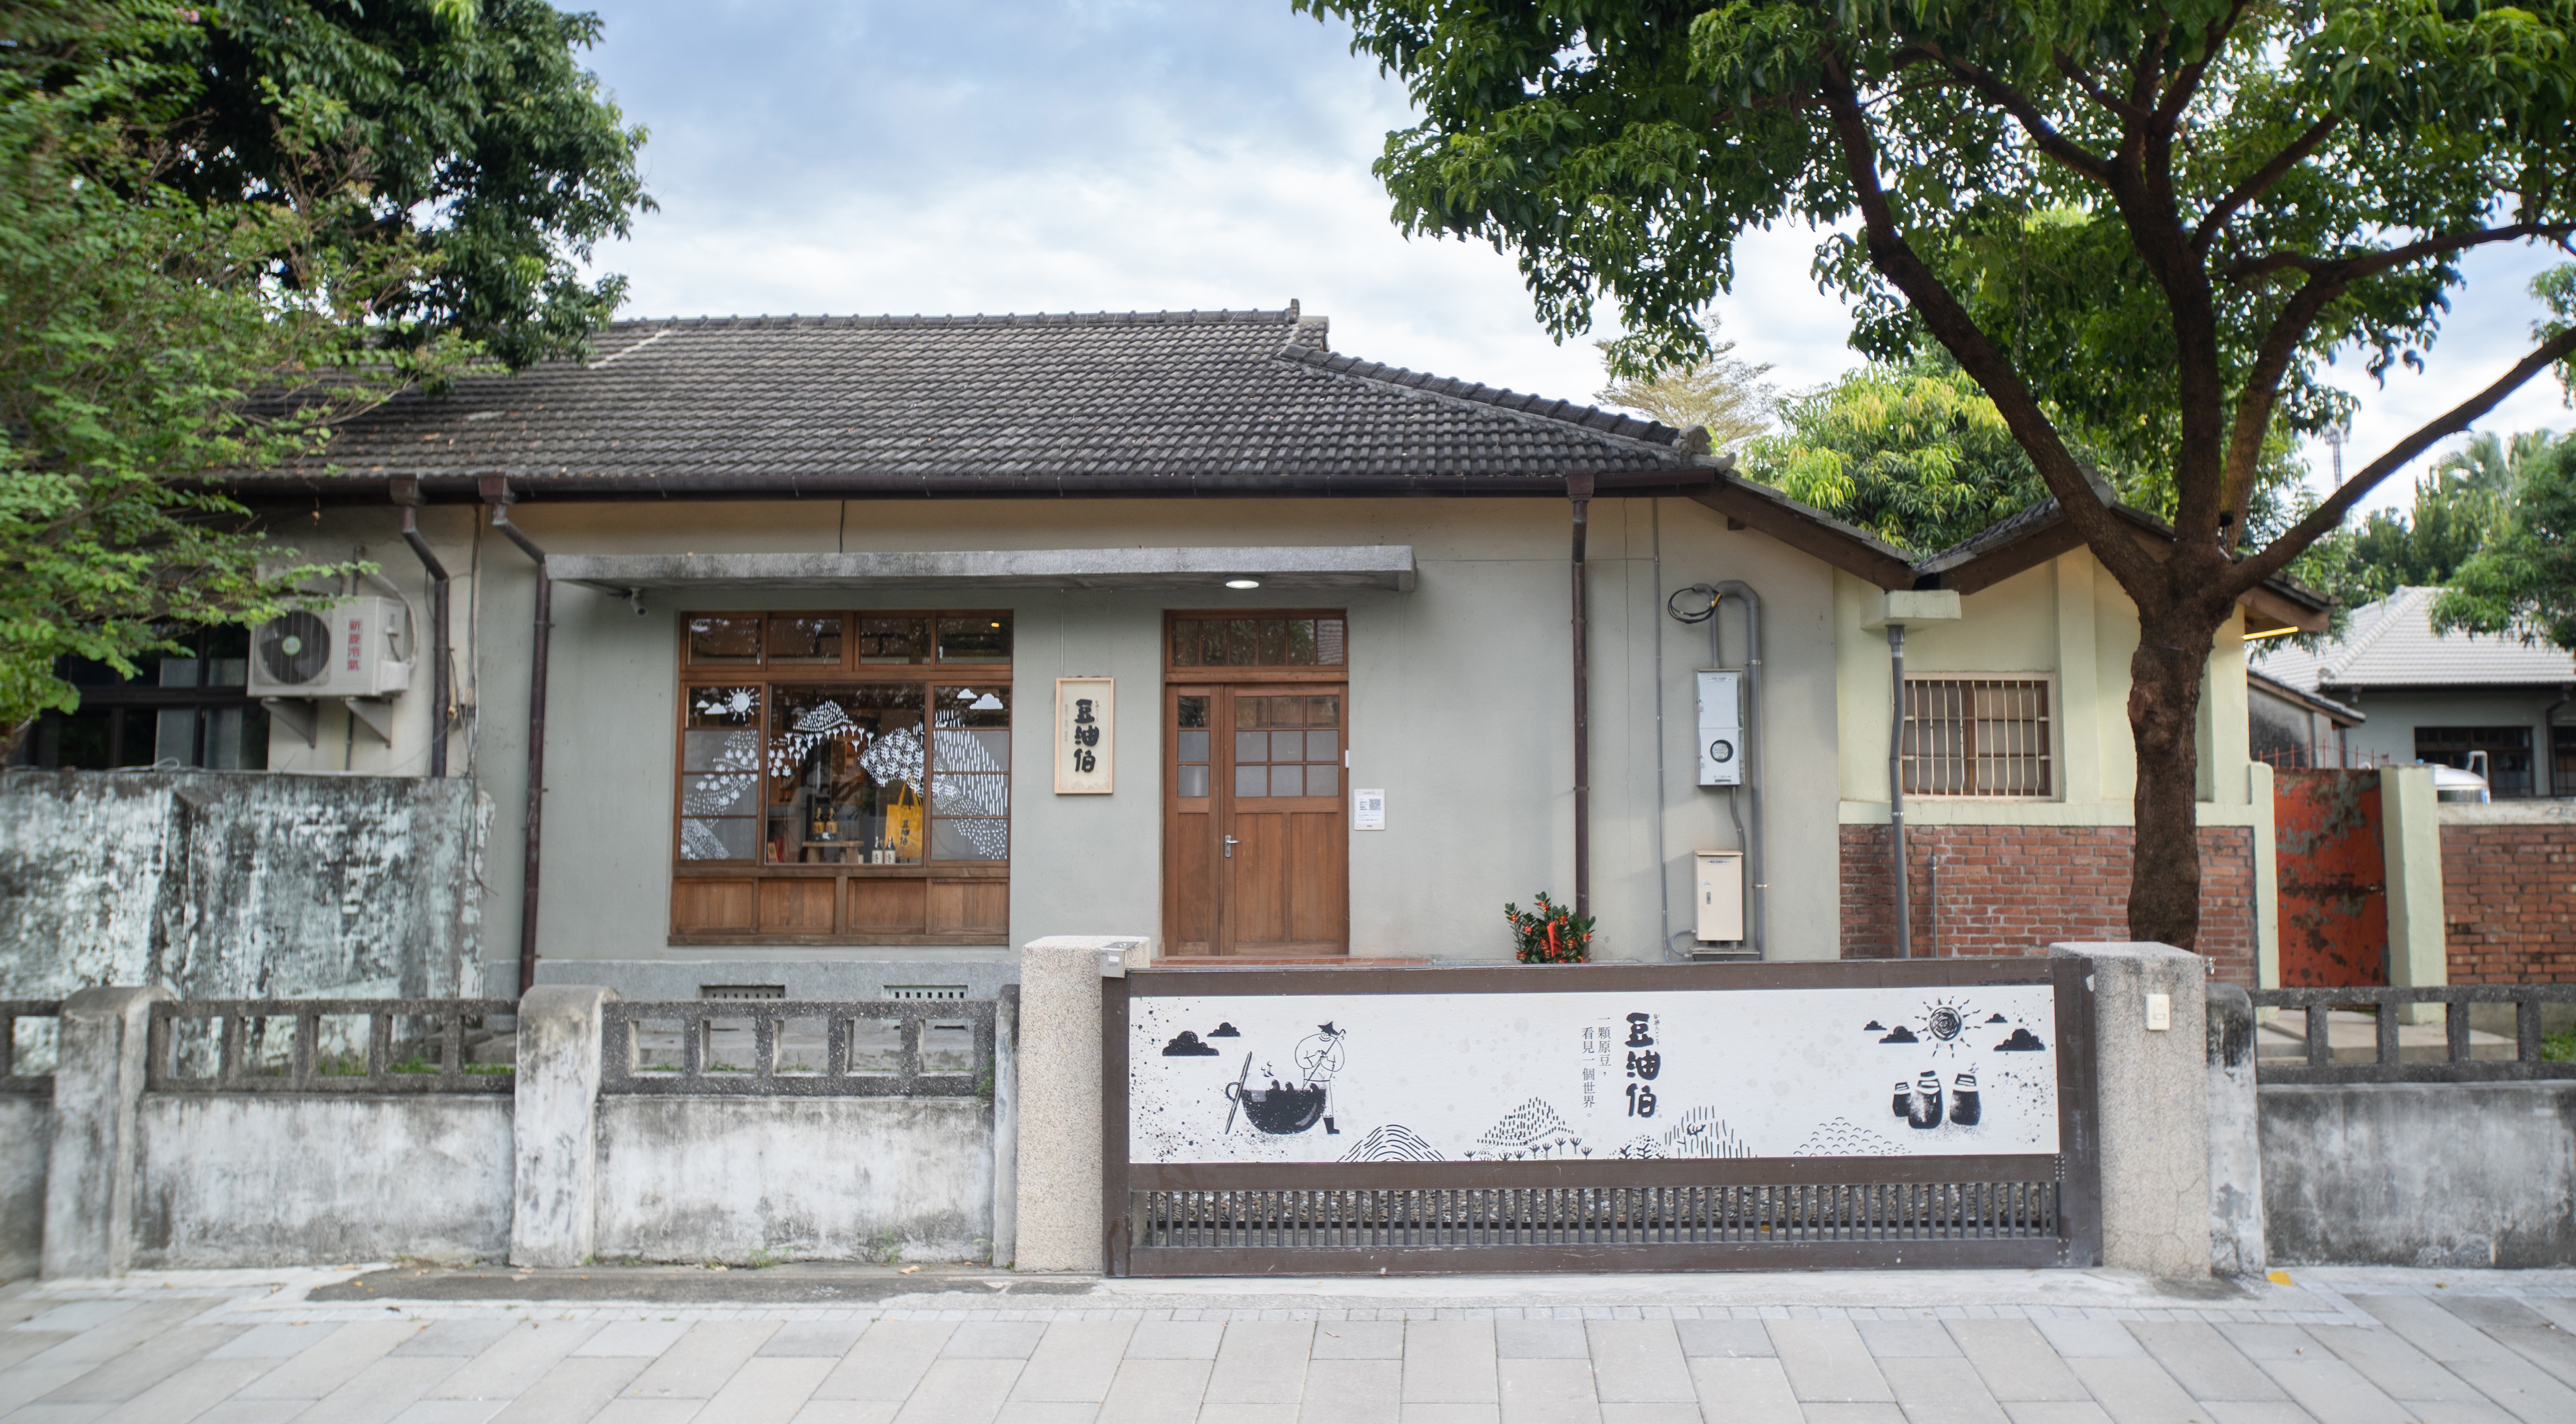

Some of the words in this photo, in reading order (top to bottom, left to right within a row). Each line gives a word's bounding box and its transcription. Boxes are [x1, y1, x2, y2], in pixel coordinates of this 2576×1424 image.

[1074, 699, 1099, 773] 豆油伯
[1582, 1026, 1596, 1118] 看見一個世界。
[1597, 1017, 1611, 1077] 一顆原豆，
[1624, 1013, 1662, 1118] 豆油伯
